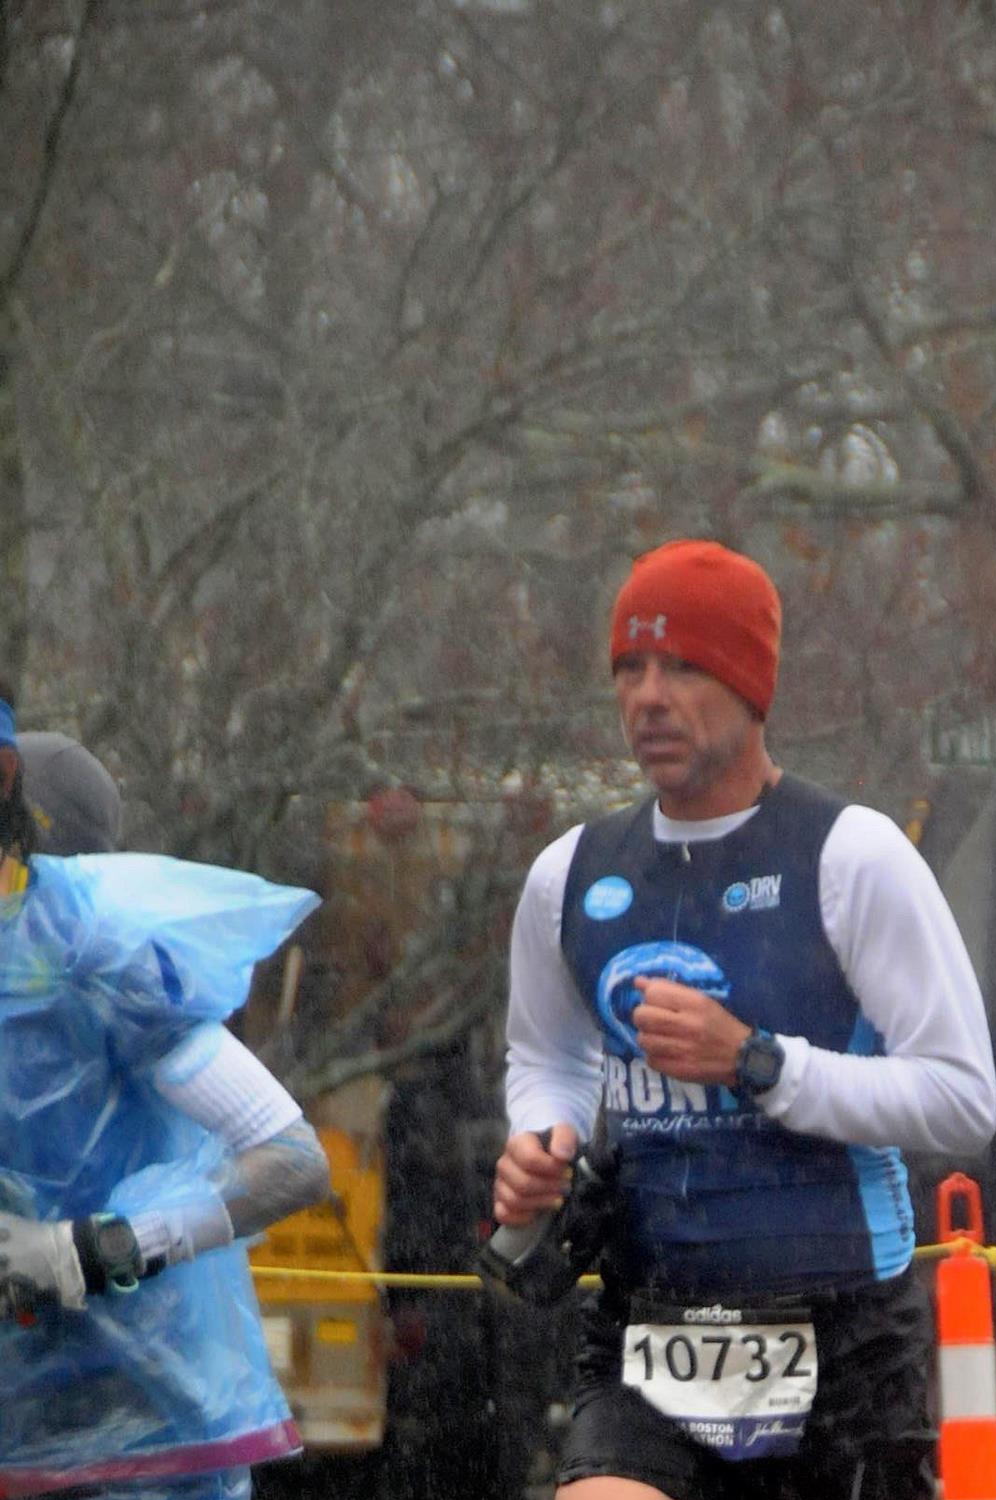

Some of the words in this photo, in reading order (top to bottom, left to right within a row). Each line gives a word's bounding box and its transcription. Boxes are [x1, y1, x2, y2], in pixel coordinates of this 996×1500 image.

[683, 1304, 742, 1323] adidas
[633, 1331, 813, 1382] 10732
[689, 1422, 735, 1434] BOSTON
